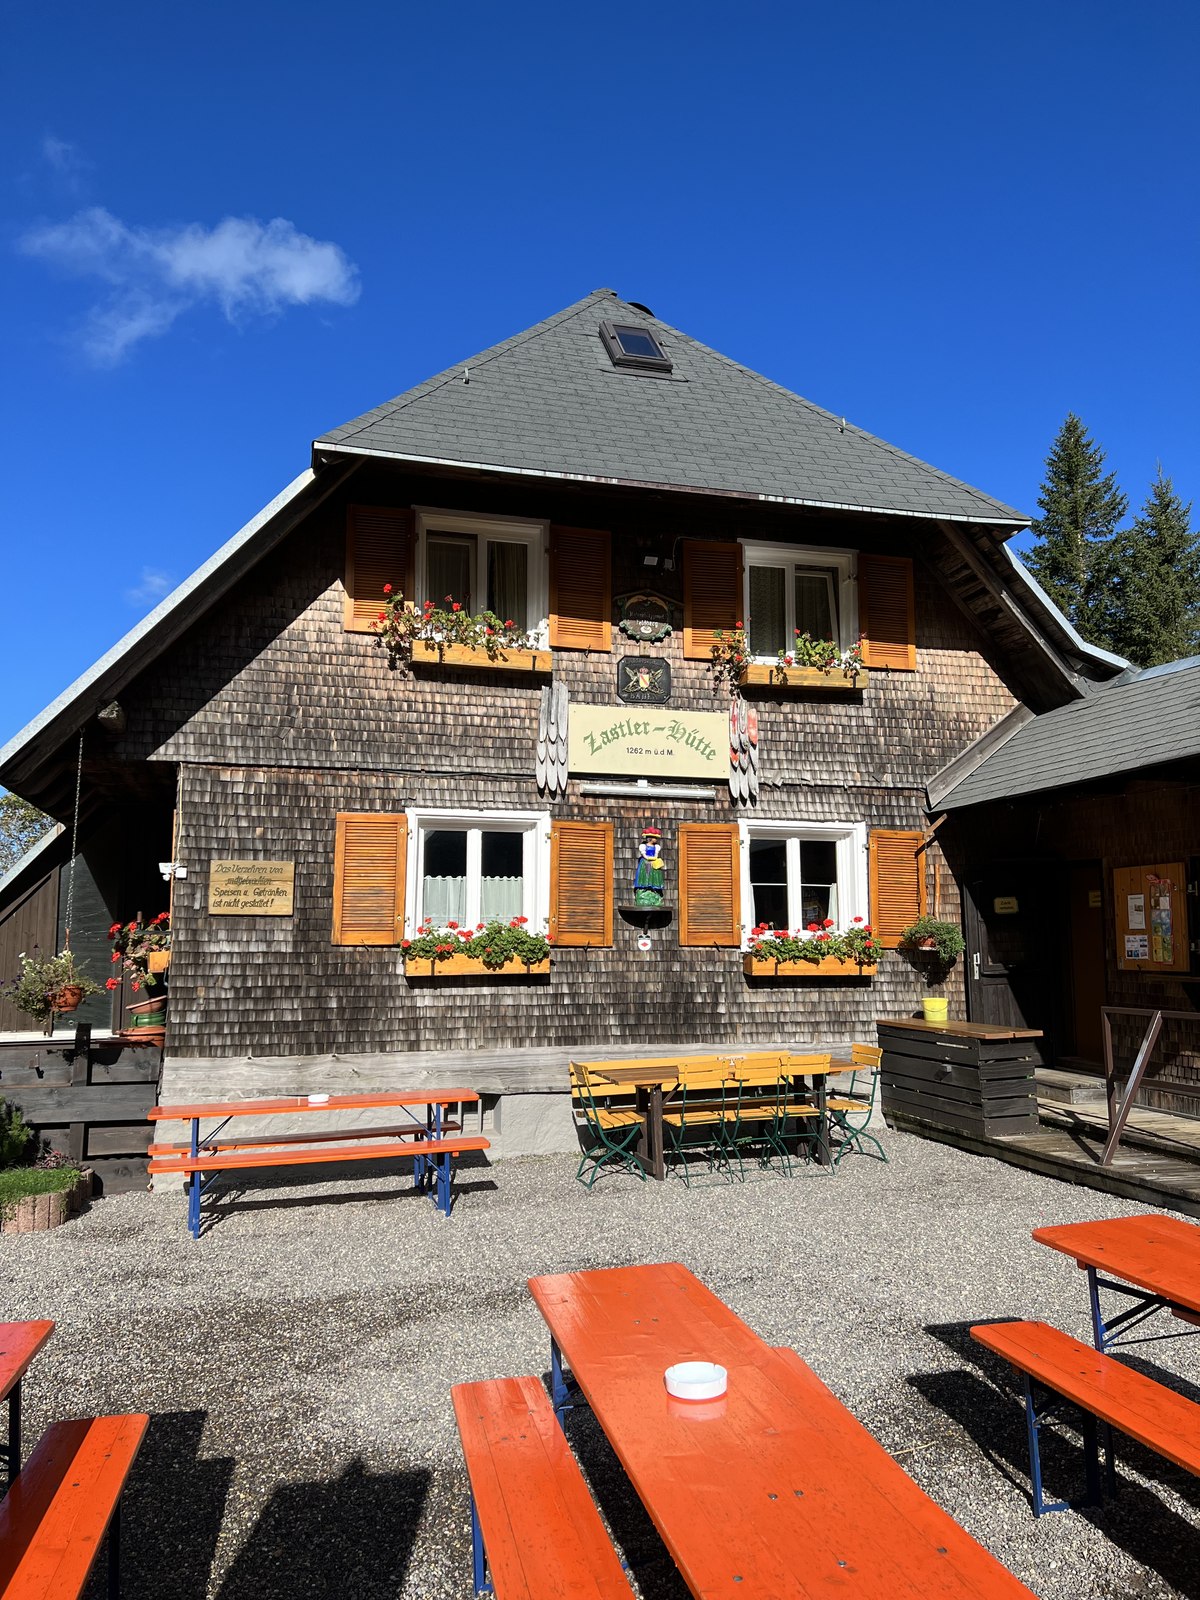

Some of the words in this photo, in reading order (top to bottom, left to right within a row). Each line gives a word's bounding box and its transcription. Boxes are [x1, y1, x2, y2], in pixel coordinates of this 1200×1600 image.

[583, 717, 717, 761] Zastler-Hütte
[626, 747, 643, 755] 1262
[214, 864, 231, 873] Das
[232, 864, 268, 874] Verzehren
[213, 887, 242, 897] Speisen
[253, 887, 288, 897] Getränken
[212, 899, 223, 908] ist
[223, 898, 240, 908] nicht
